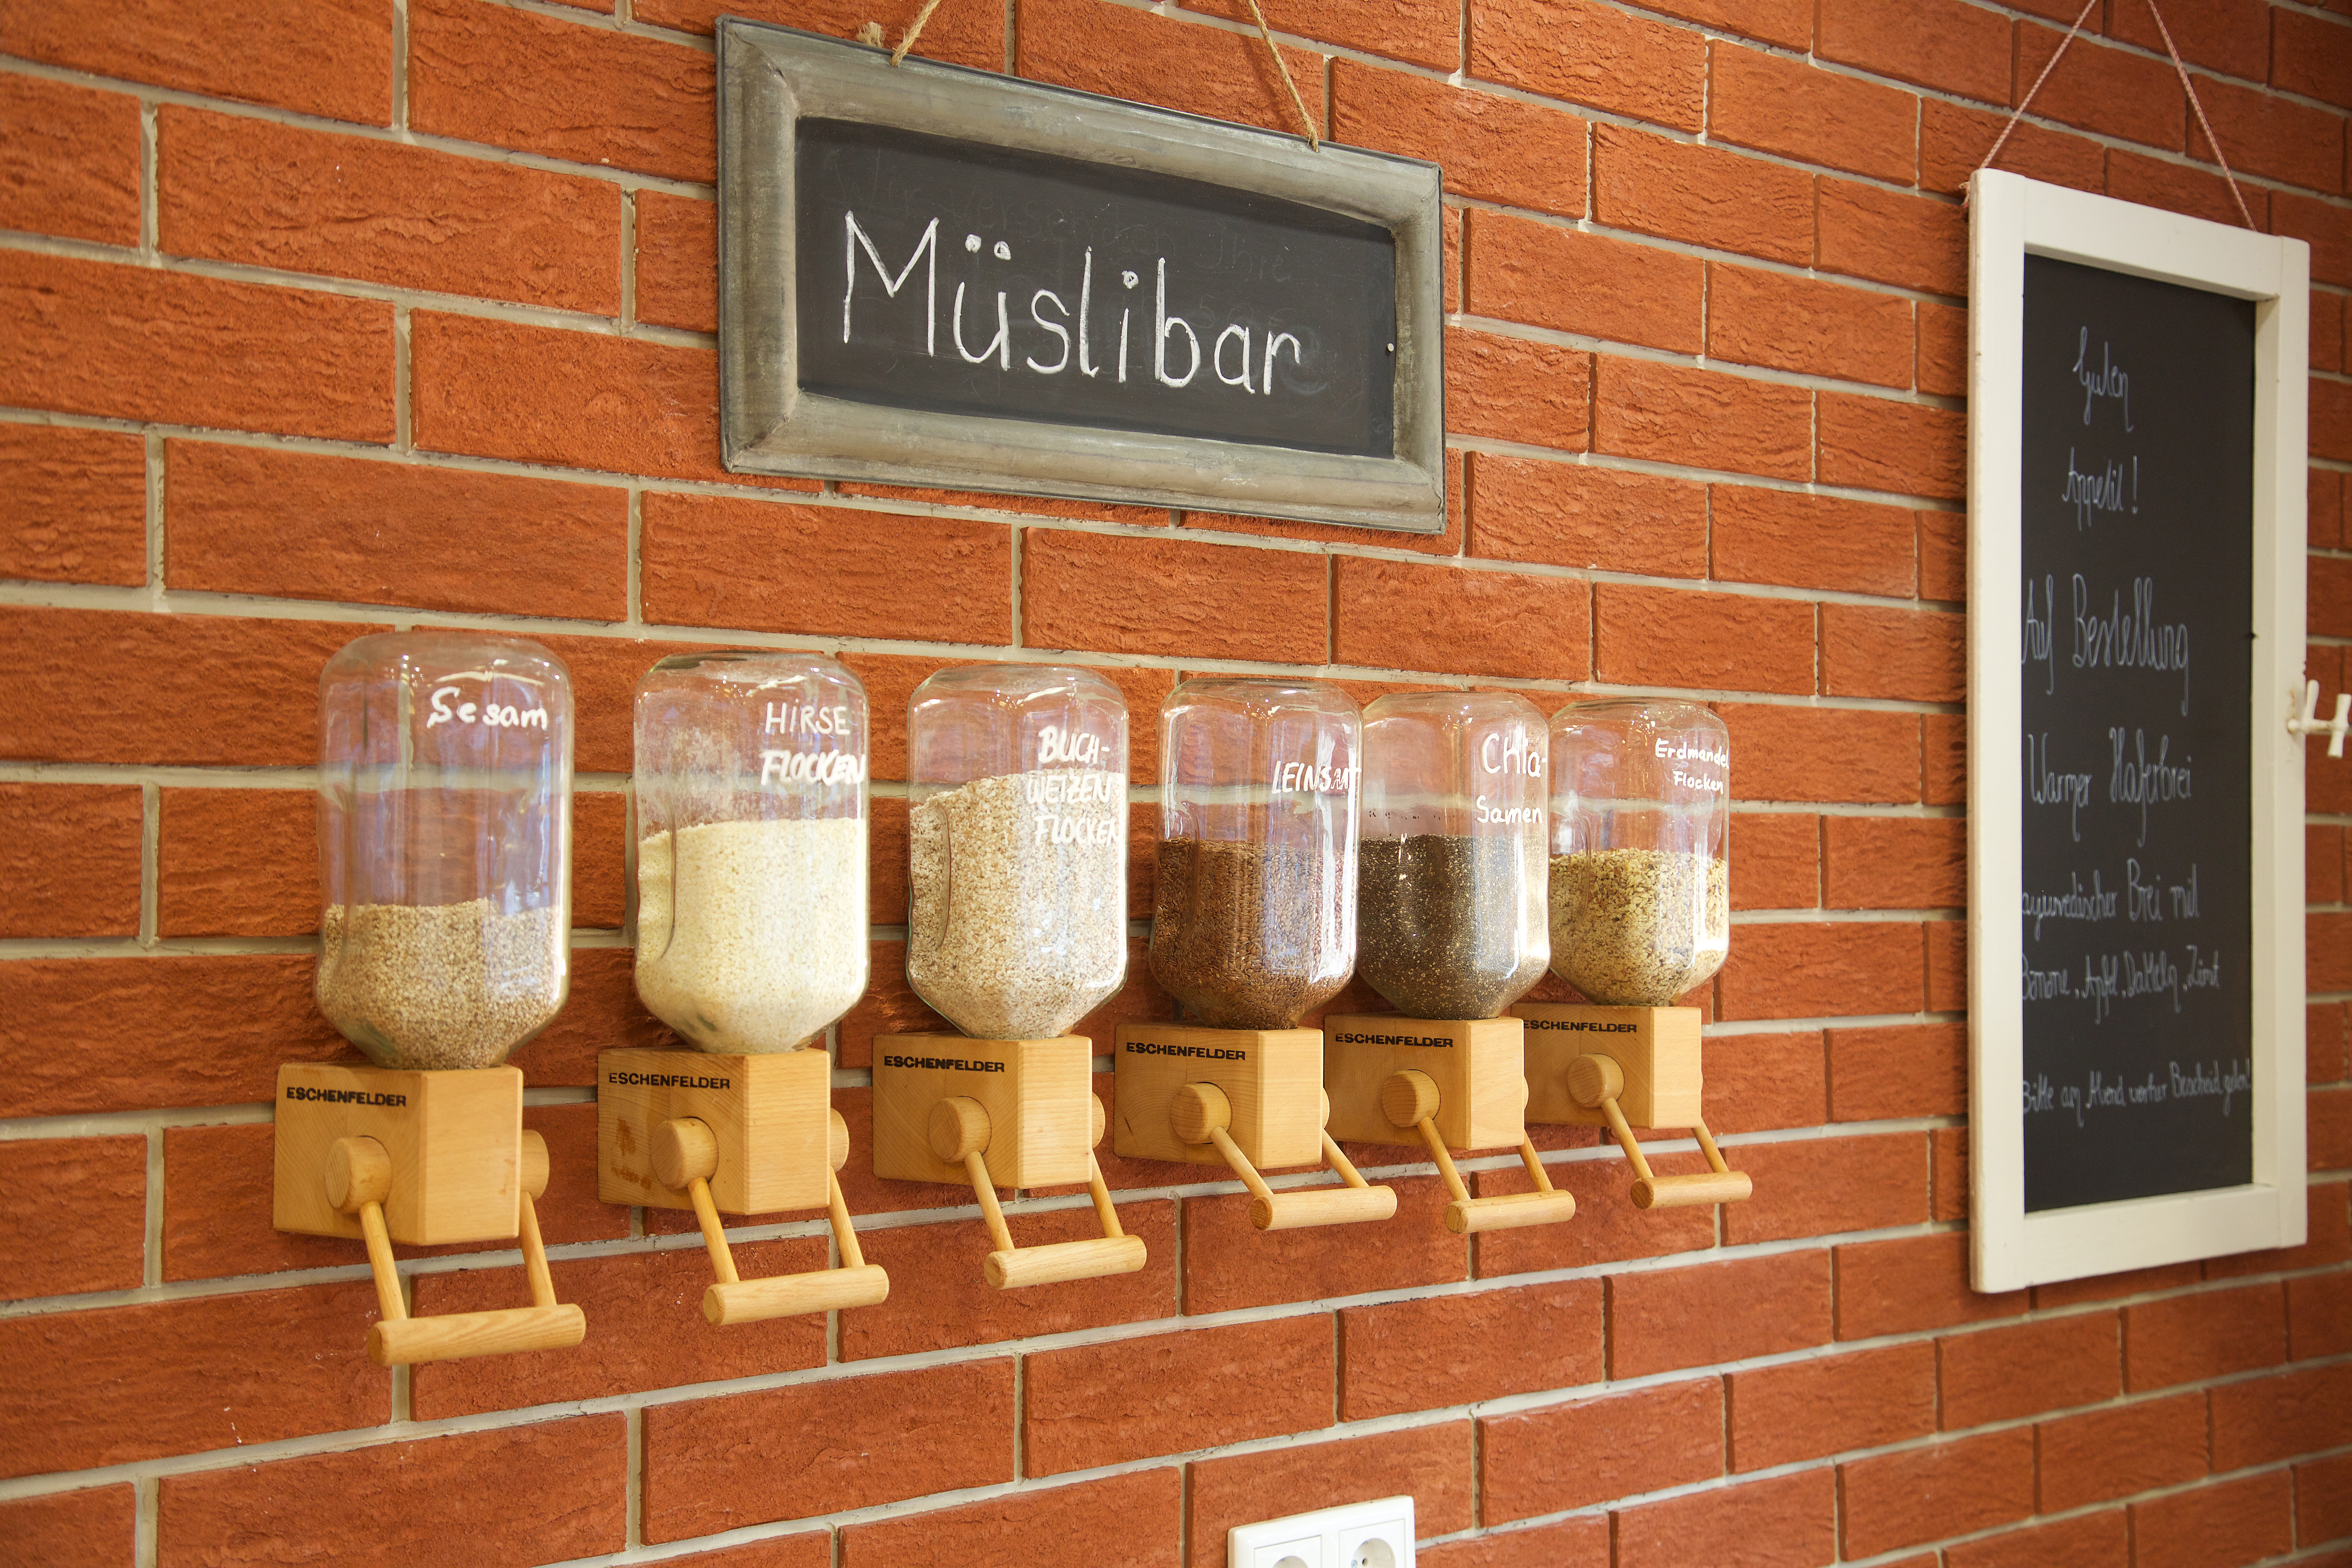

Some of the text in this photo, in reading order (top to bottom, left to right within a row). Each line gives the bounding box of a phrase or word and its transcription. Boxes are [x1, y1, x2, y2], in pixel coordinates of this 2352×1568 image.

[844, 210, 1301, 395] Müslibar
[2072, 572, 2189, 716] Bestellung
[427, 686, 548, 731] Sesam
[1038, 725, 1110, 764] BUCH-
[1655, 737, 1730, 769] Erdmandel
[1673, 770, 1724, 794] Flocken
[2027, 733, 2092, 842] Warmer
[1476, 795, 1543, 825] Samen
[2127, 858, 2163, 921] Brei
[2169, 863, 2200, 919] mit
[1335, 1033, 1453, 1048] ESCHENFELDER
[1523, 1019, 1637, 1033] ESCHENFELDER
[884, 1056, 1004, 1073] ESCHENFELDER
[1126, 1042, 1246, 1060] ESCHENFELDER
[609, 1073, 730, 1089] ESCHENFELDER
[286, 1087, 407, 1107] ESCHENFELDER
